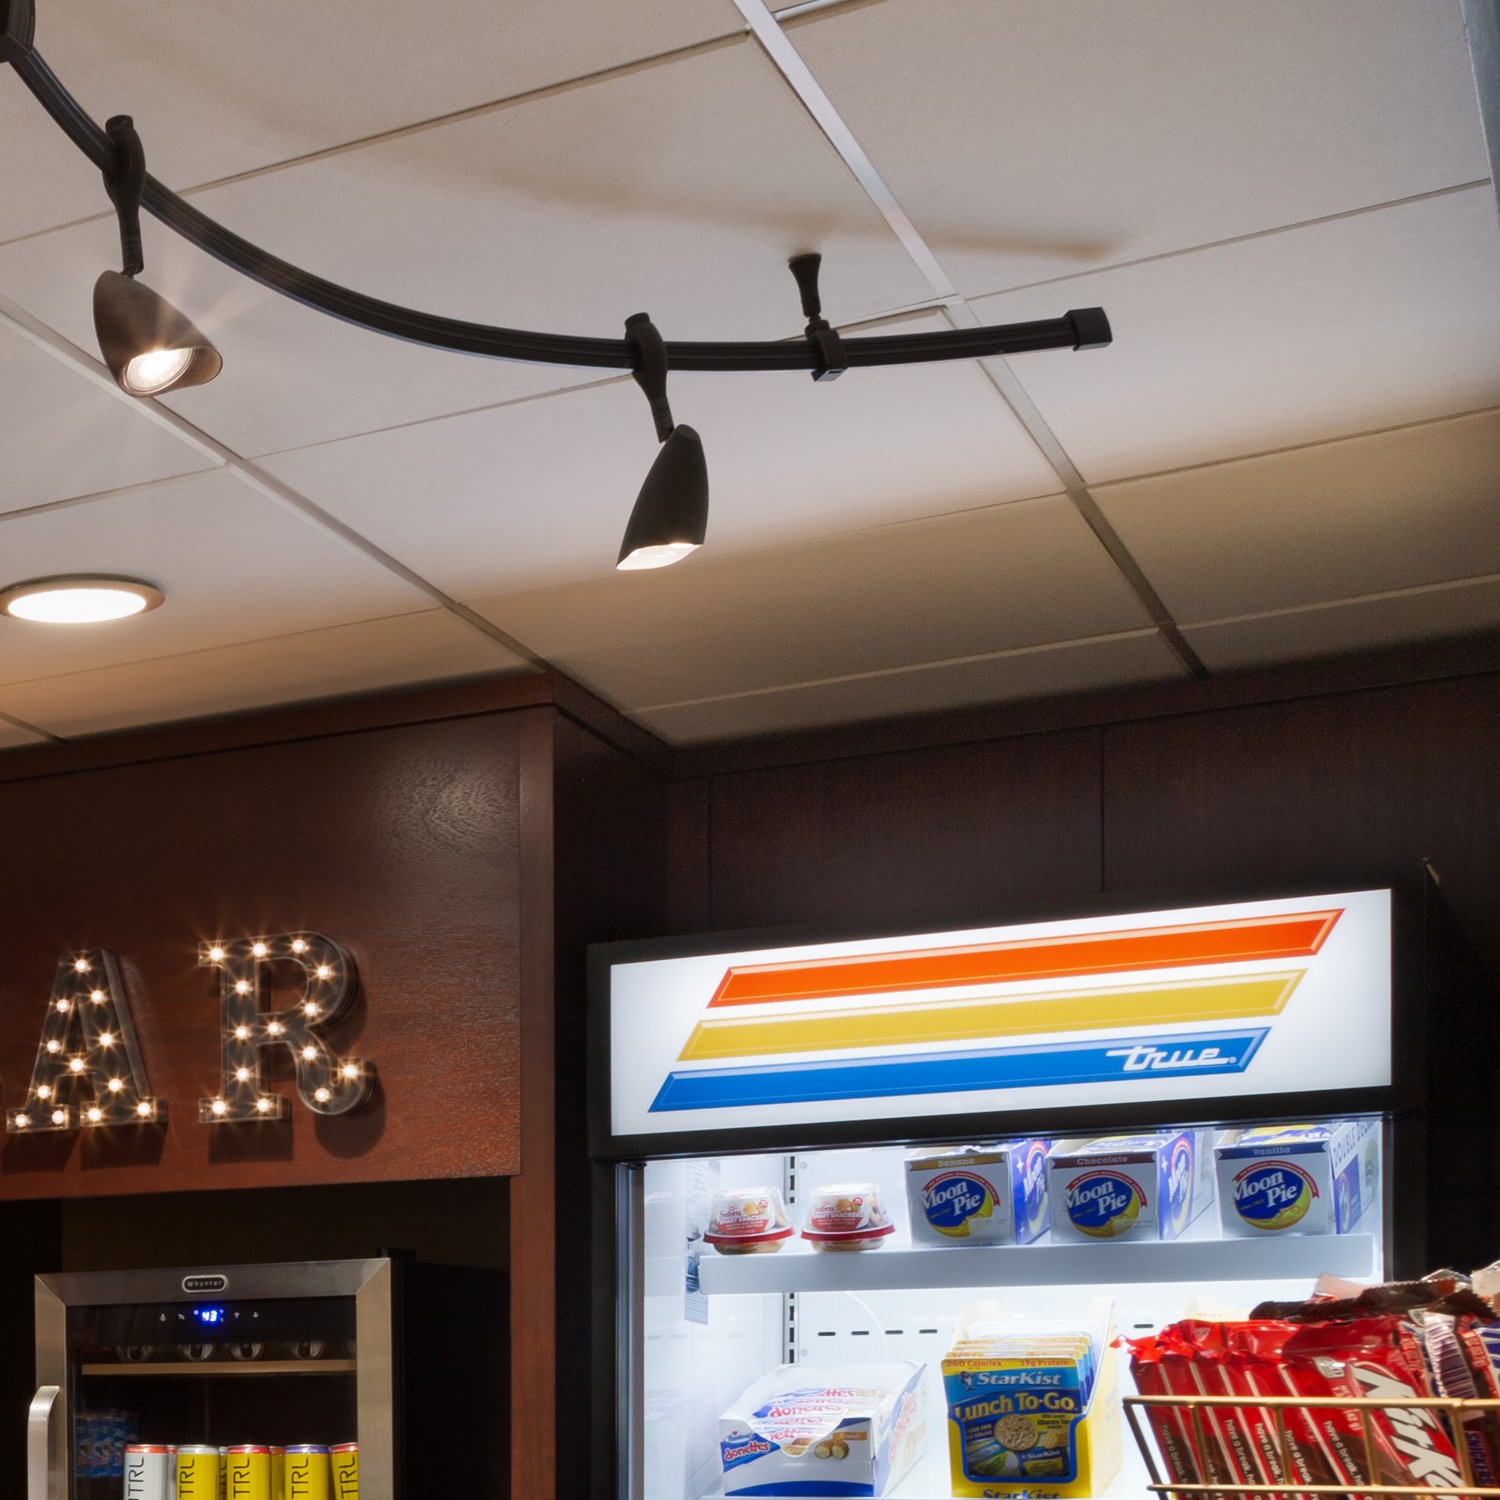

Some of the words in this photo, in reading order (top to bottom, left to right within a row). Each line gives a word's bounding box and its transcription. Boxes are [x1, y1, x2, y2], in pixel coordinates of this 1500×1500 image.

[1106, 1045, 1229, 1071] true
[938, 1158, 975, 1167] Banana
[1077, 1155, 1128, 1165] Chocolate
[1252, 1147, 1291, 1155] Vanilla
[923, 1178, 968, 1210] Moon
[1067, 1177, 1114, 1208] Moon
[1233, 1171, 1284, 1201] Moon
[1266, 1184, 1298, 1208] Pie
[719, 1208, 742, 1218] Sabra
[952, 1193, 980, 1217] Pie
[1098, 1191, 1126, 1216] Pie
[187, 1279, 223, 1288] Whynter
[202, 1310, 217, 1321] 43
[977, 1372, 1061, 1385] StarKist
[955, 1395, 1013, 1421] Lunch
[1015, 1392, 1074, 1411] To-Go
[1225, 1419, 1237, 1442] have
[1325, 1420, 1337, 1443] have
[724, 1441, 769, 1460] donettes
[1027, 1450, 1060, 1459] StarKist
